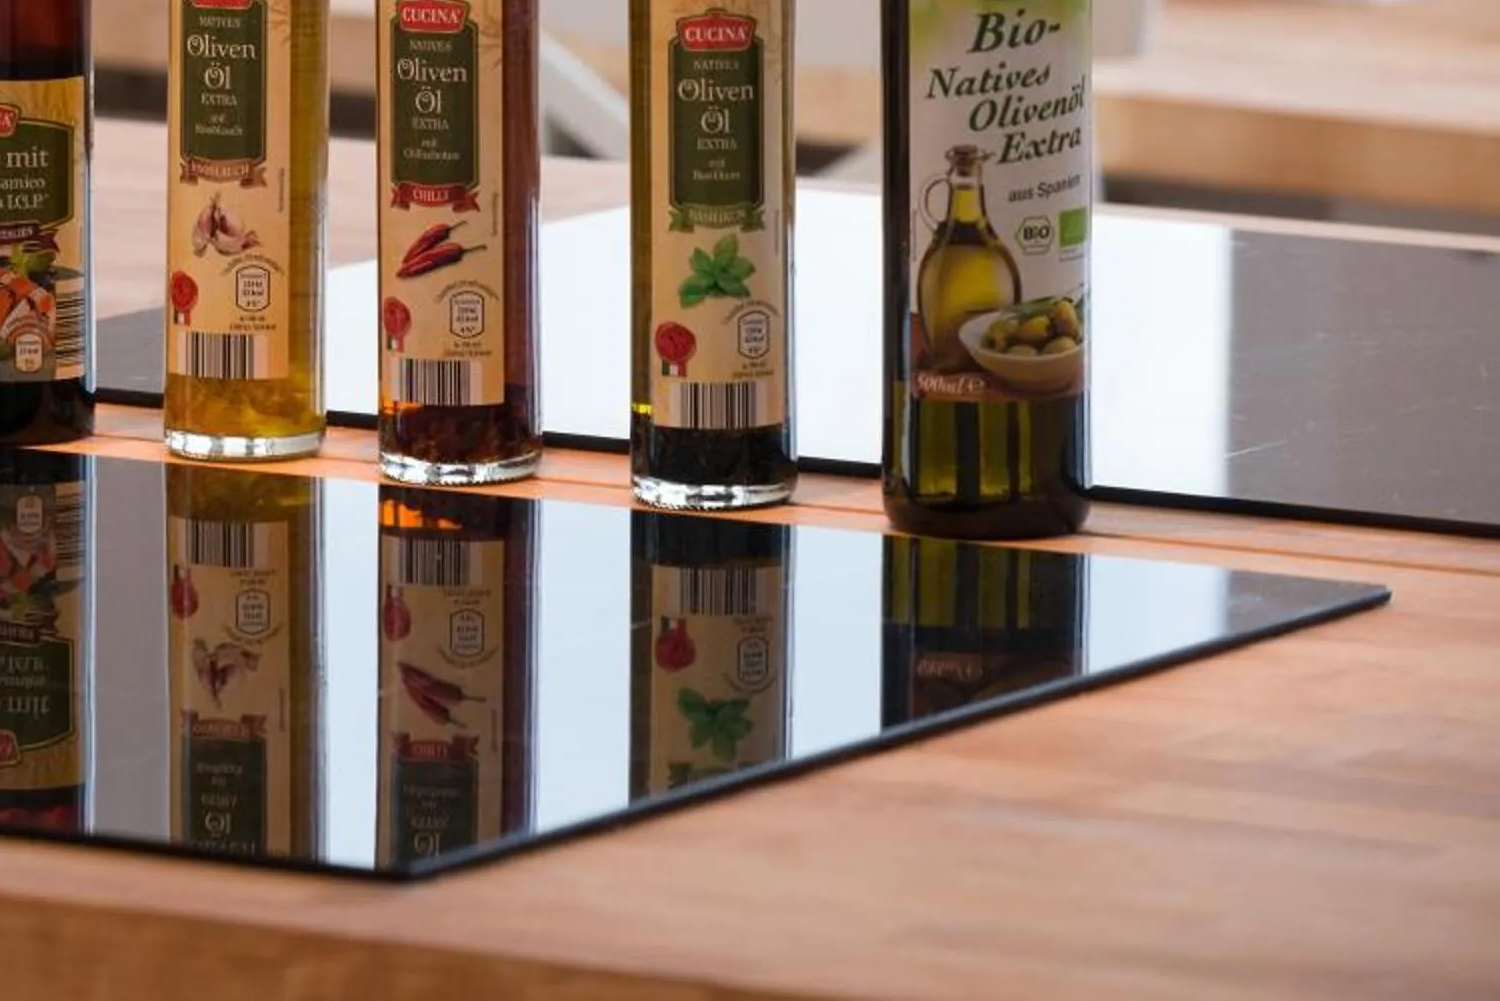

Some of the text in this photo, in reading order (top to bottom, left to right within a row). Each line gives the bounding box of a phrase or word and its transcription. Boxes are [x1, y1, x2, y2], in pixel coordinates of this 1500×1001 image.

[402, 6, 461, 24] CUCINA
[684, 26, 747, 43] CUCINA
[967, 8, 1061, 54] Bio-
[187, 33, 256, 59] Oliven
[204, 62, 231, 89] Öl
[397, 57, 468, 82] Oliven
[926, 61, 1052, 98] Natives
[201, 94, 237, 106] EXTRA
[414, 86, 441, 114] Öl
[678, 78, 754, 102] Oliven
[968, 74, 1086, 132] Olivenöl
[412, 118, 449, 130] EXTRA
[701, 106, 729, 133] Öl
[697, 137, 737, 150] EXTRA
[997, 126, 1082, 165] Extra
[6, 145, 50, 169] mit
